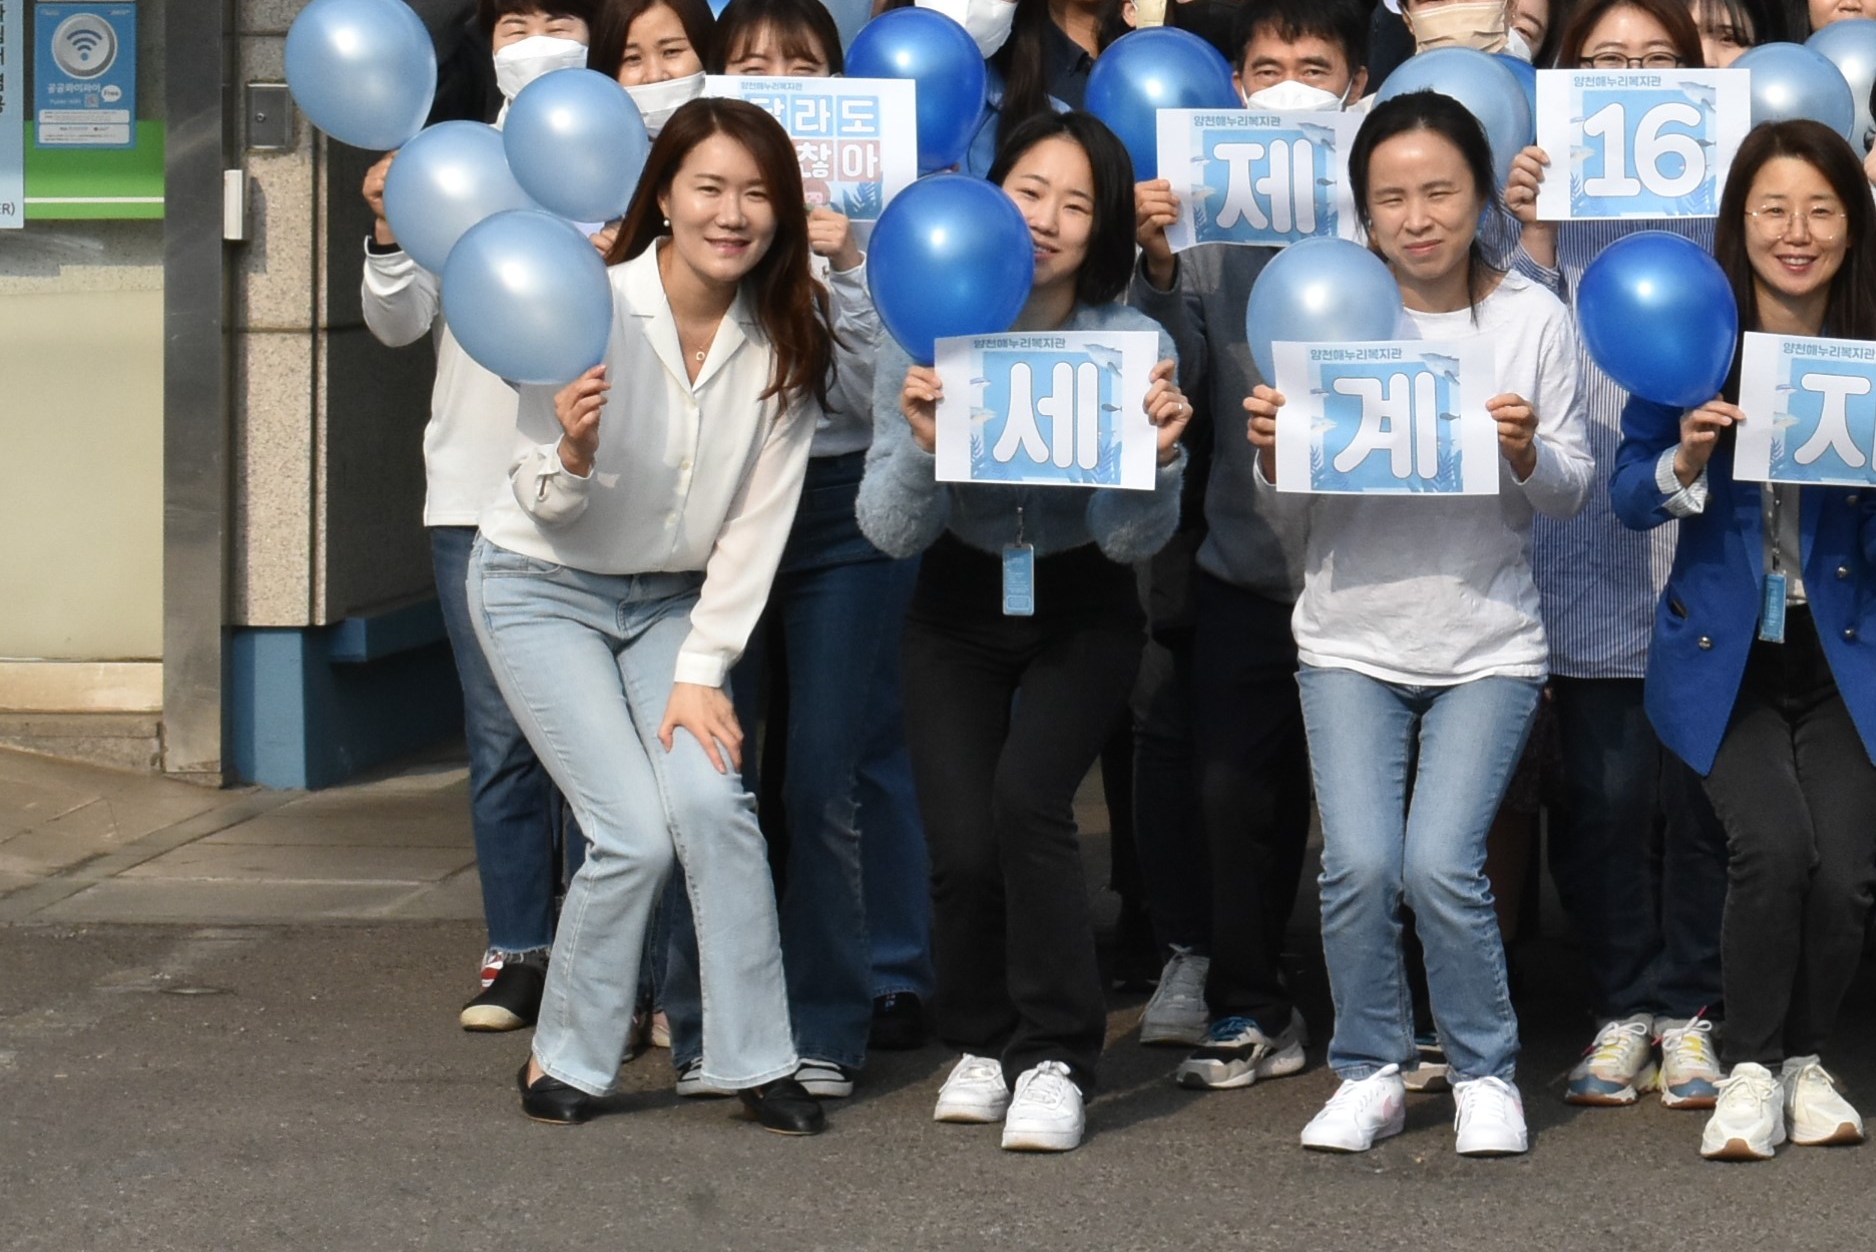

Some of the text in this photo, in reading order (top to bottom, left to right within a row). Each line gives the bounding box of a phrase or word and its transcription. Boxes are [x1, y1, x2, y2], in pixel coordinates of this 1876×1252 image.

[47, 82, 101, 94] 공공와이파이
[1573, 75, 1662, 88] 양천해누리복지관
[1194, 115, 1281, 127] 양천해누리복지관
[1583, 101, 1707, 198] 16
[796, 141, 879, 179] 찮아
[1213, 139, 1317, 235] 제
[973, 337, 1066, 349] 양천해누리복지관
[1783, 342, 1875, 360] 양천해누리복지관
[1310, 348, 1402, 361] 양천해누리복지관
[991, 360, 1099, 471] 세
[1332, 369, 1439, 480] 계
